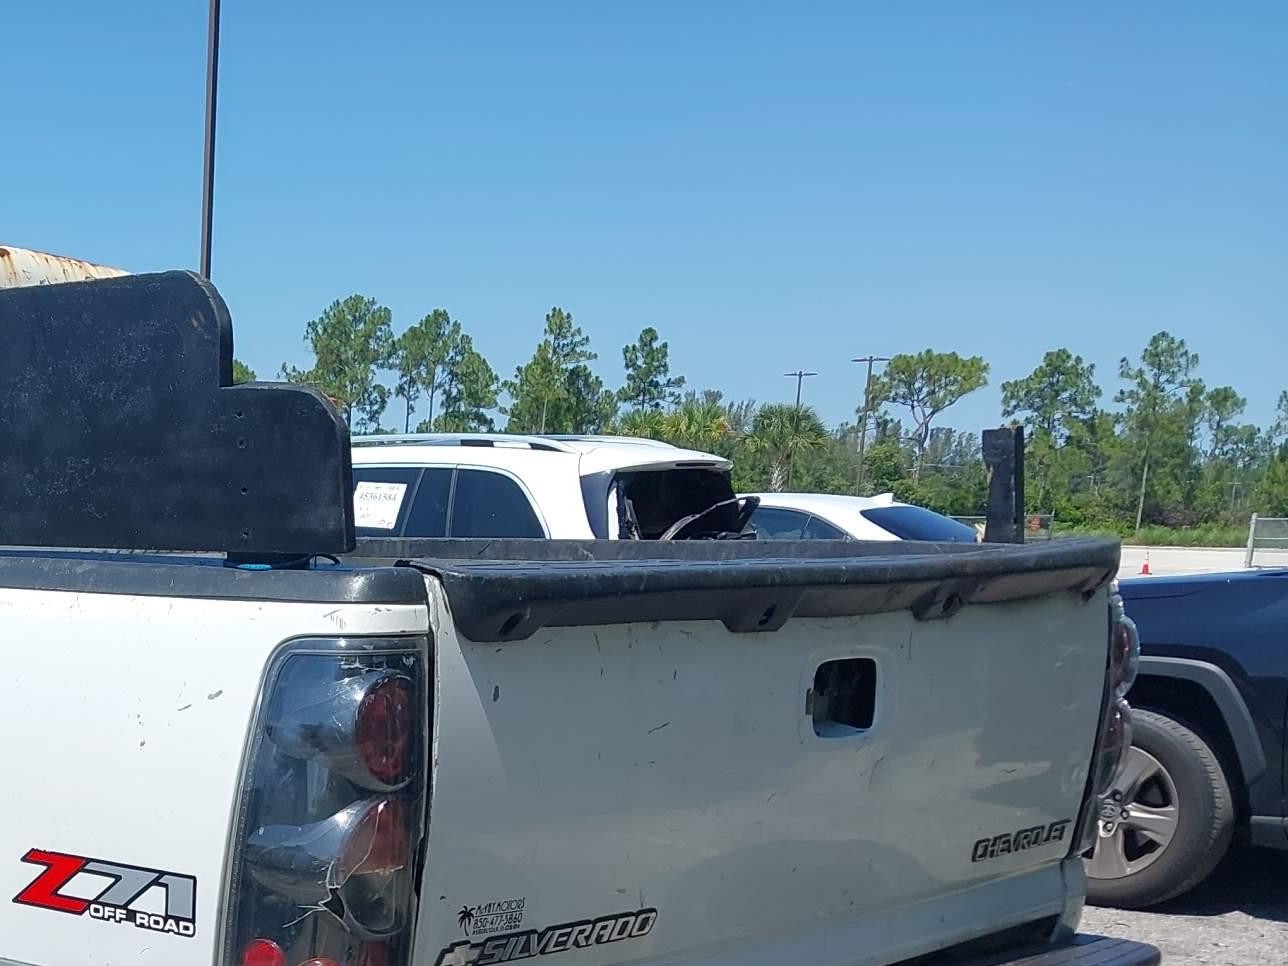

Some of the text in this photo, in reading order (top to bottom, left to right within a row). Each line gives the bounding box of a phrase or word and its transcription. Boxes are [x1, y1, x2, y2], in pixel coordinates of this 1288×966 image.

[11, 847, 197, 922] Z71
[88, 903, 196, 937] OFF ROAD
[474, 908, 658, 966] SILVERADO
